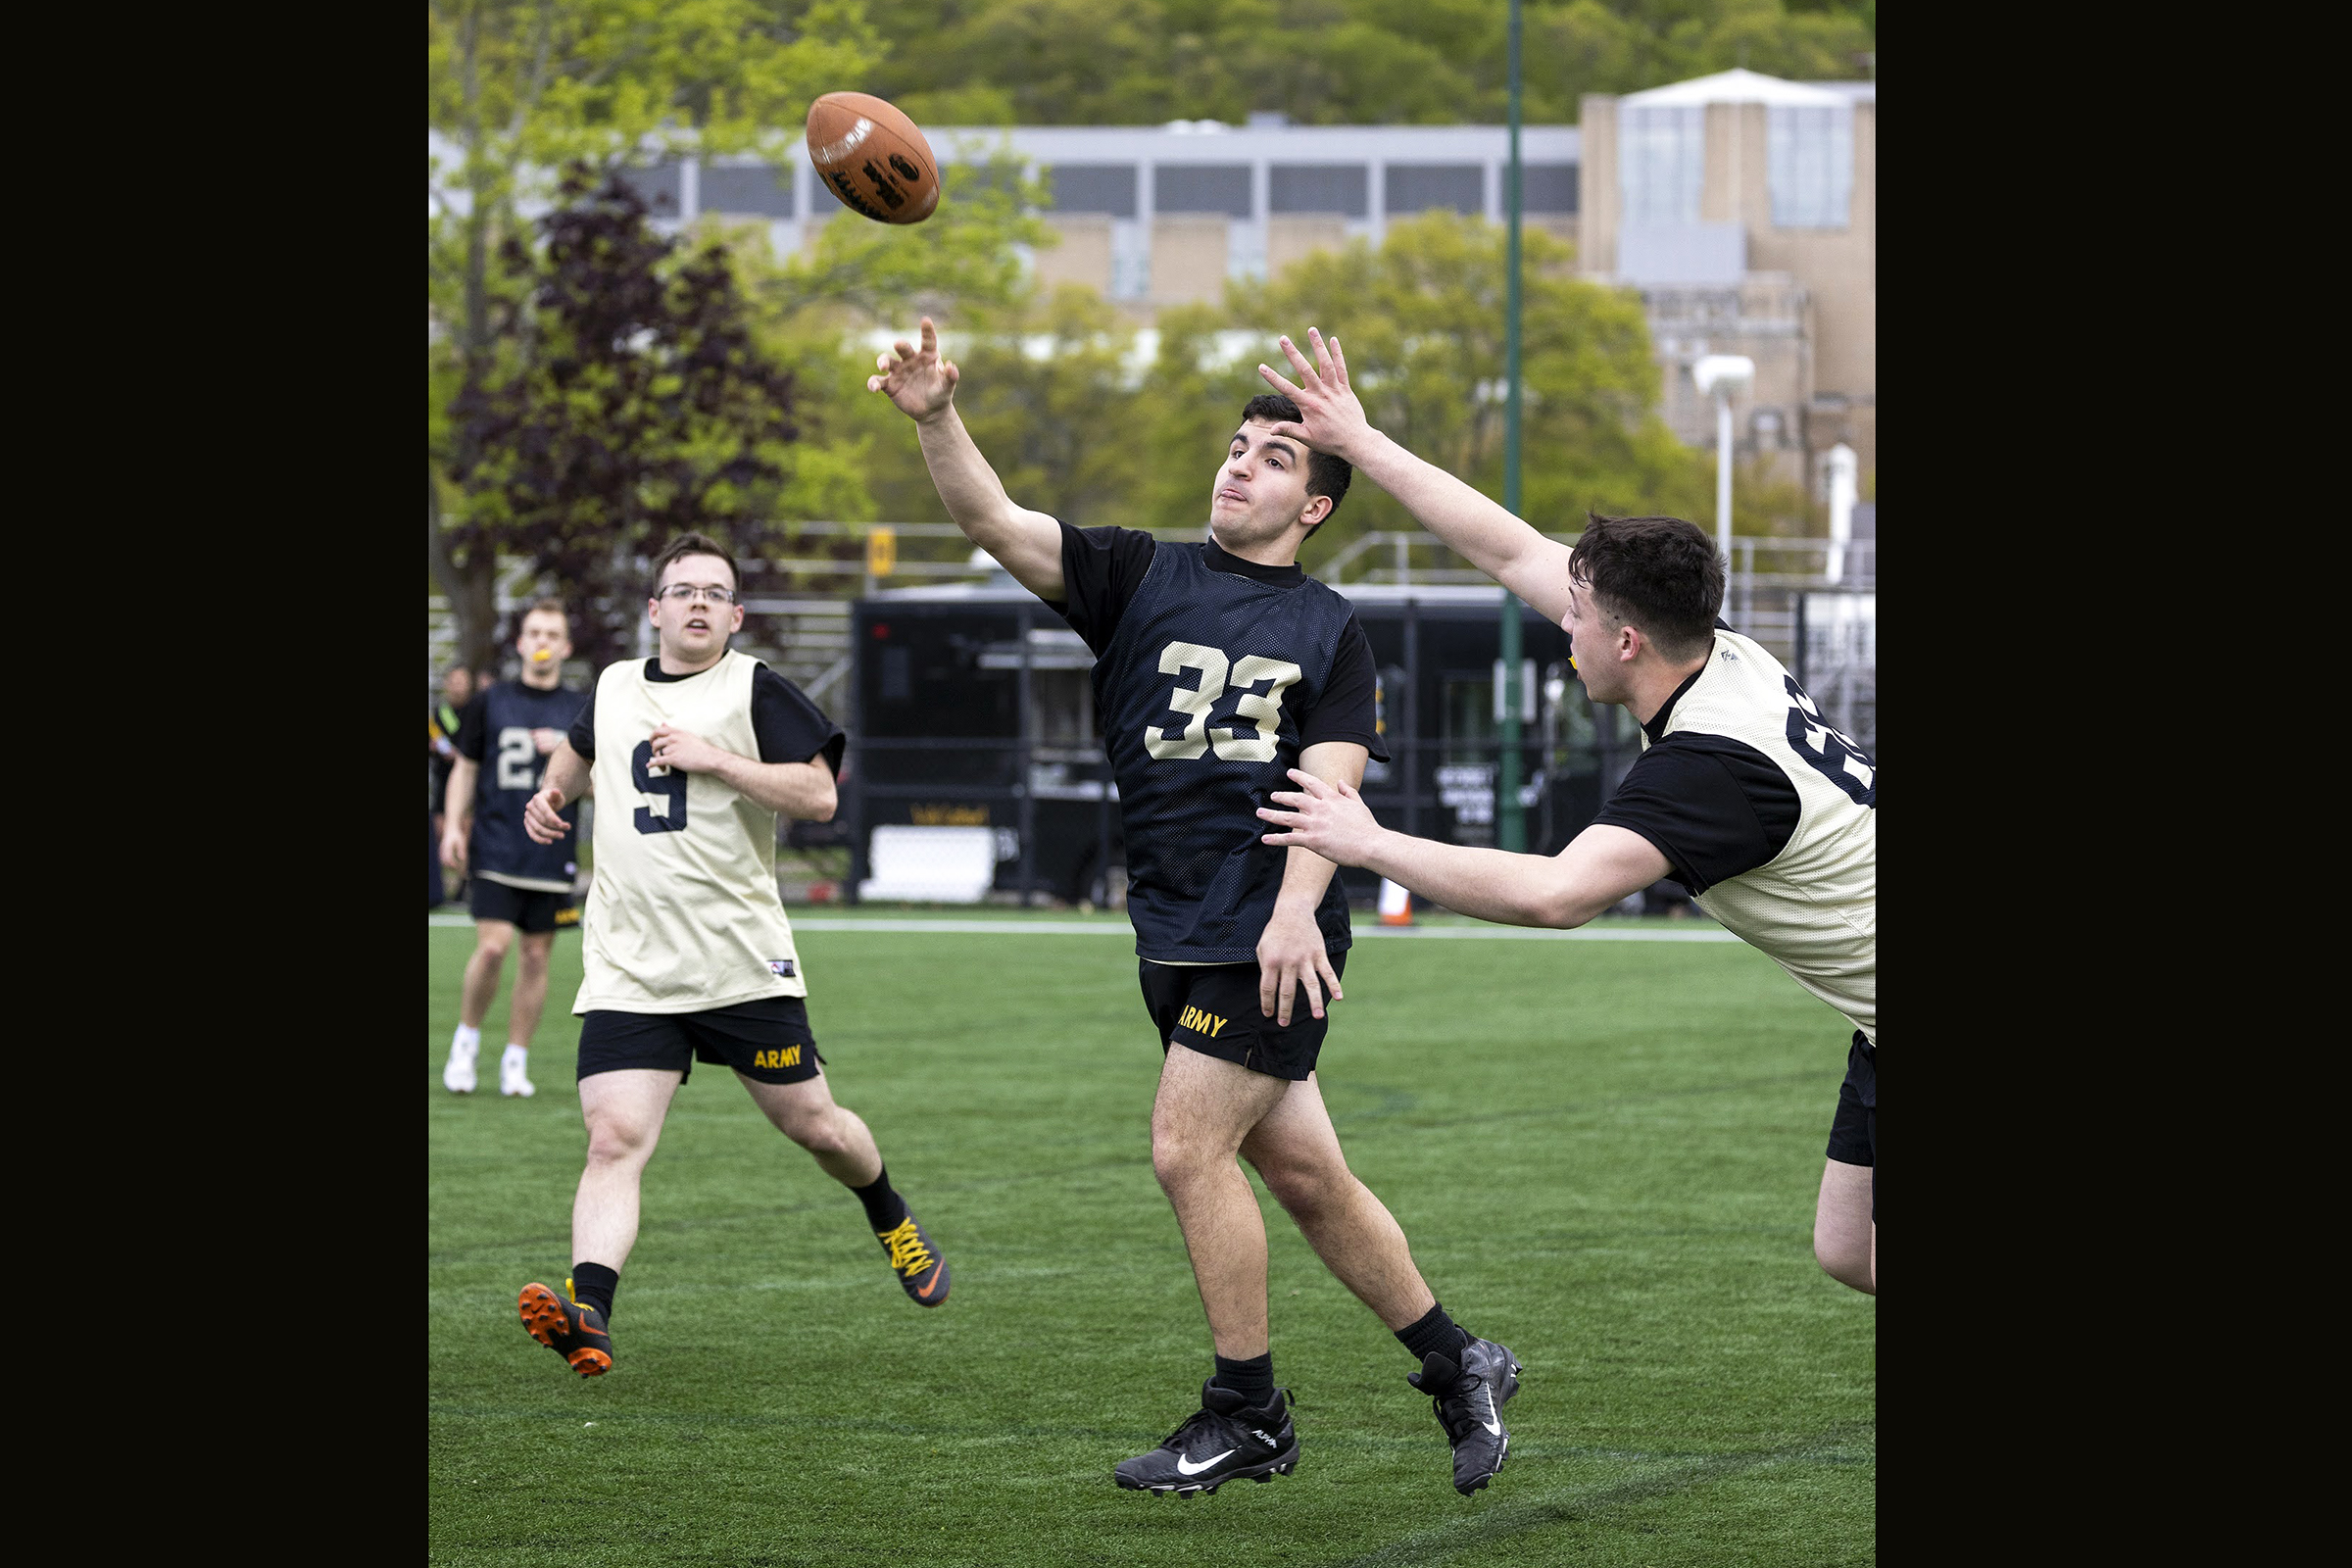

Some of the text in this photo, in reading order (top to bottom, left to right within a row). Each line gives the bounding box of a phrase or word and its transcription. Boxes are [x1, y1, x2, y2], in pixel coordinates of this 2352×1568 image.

[1145, 641, 1301, 762] 33
[631, 740, 687, 835] 9
[1178, 1004, 1228, 1038] ARMY
[754, 1044, 802, 1069] ARMY
